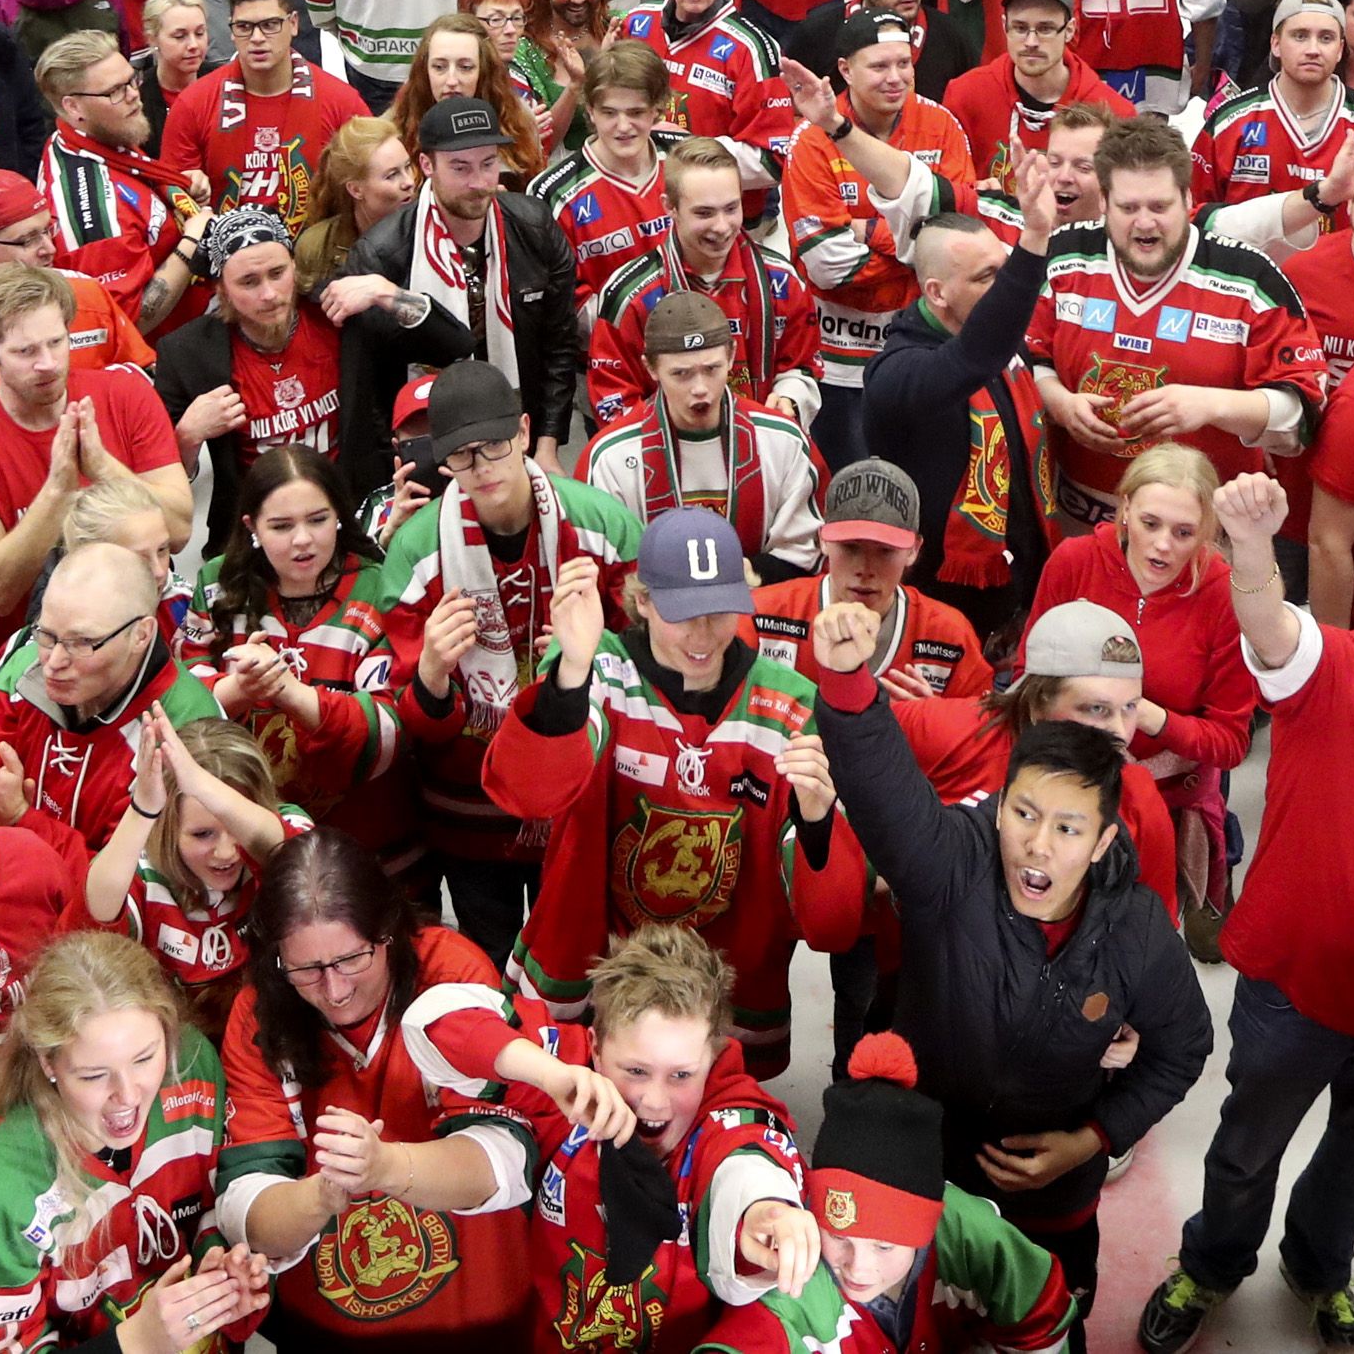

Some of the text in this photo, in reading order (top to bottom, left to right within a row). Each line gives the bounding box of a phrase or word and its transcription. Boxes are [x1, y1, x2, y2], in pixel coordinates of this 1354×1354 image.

[457, 115, 486, 128] BRXTN
[1286, 163, 1326, 181] WIBE
[1118, 336, 1149, 352] WIBE
[1323, 334, 1347, 356] NU
[273, 389, 339, 435] KÖR MOT
[832, 473, 912, 518] RED WINGS
[687, 538, 719, 580] U
[317, 1212, 452, 1293] MORA KLUBB
